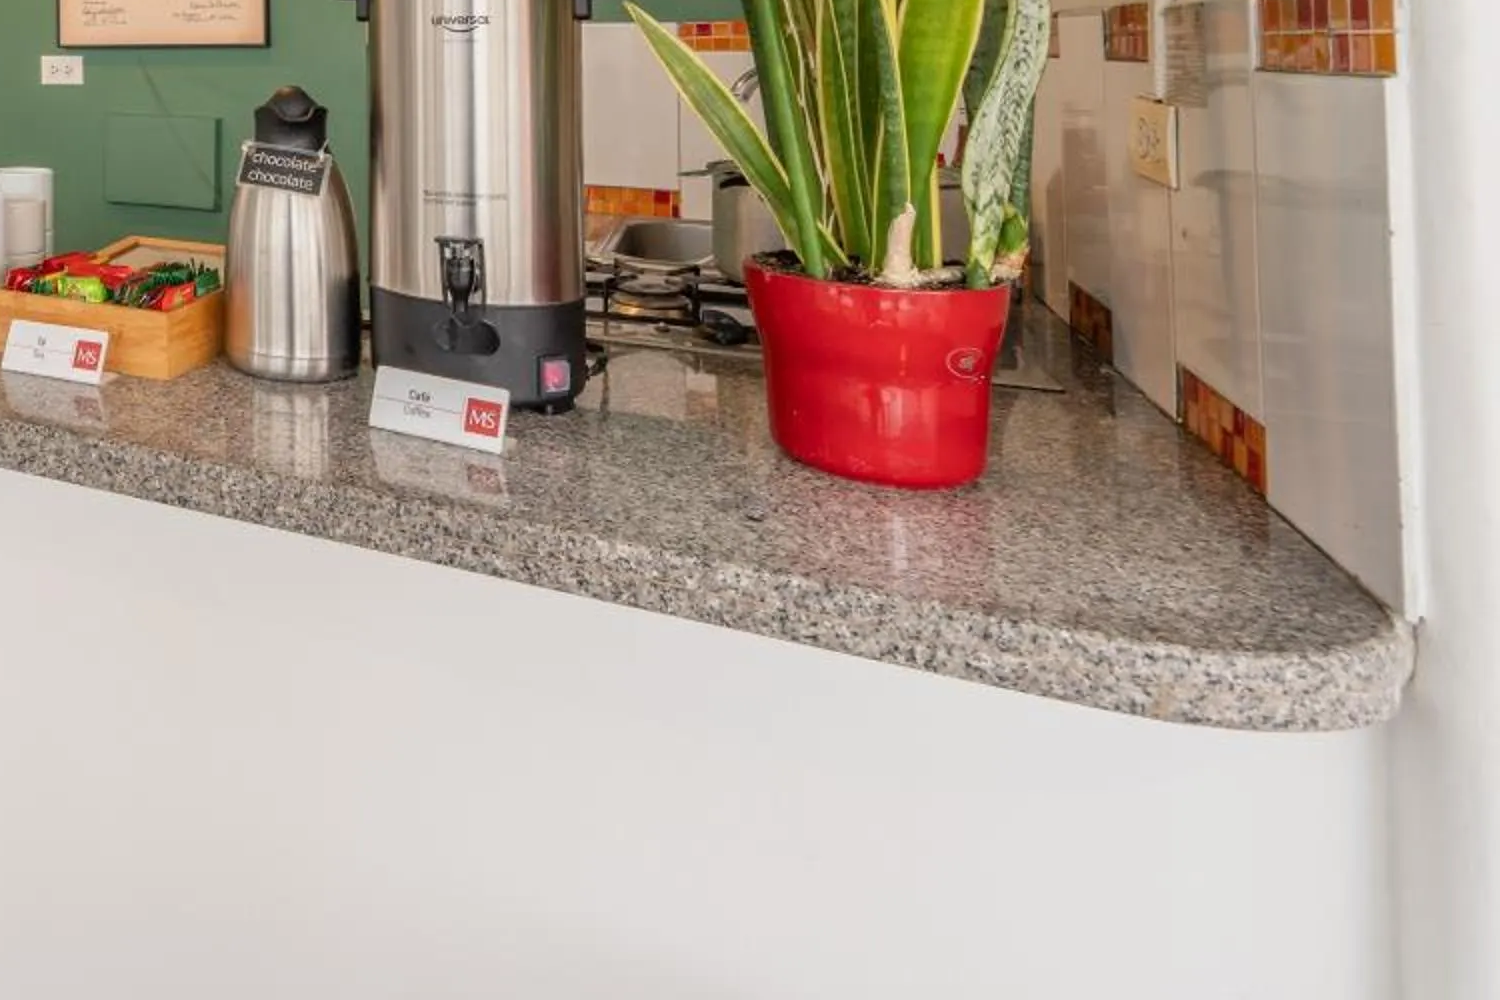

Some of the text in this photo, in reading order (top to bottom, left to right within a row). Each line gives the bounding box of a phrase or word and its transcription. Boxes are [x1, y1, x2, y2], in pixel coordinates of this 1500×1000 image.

[251, 151, 318, 173] chocolate
[247, 167, 313, 191] chocolate
[76, 347, 98, 366] MS
[467, 408, 497, 430] MS
